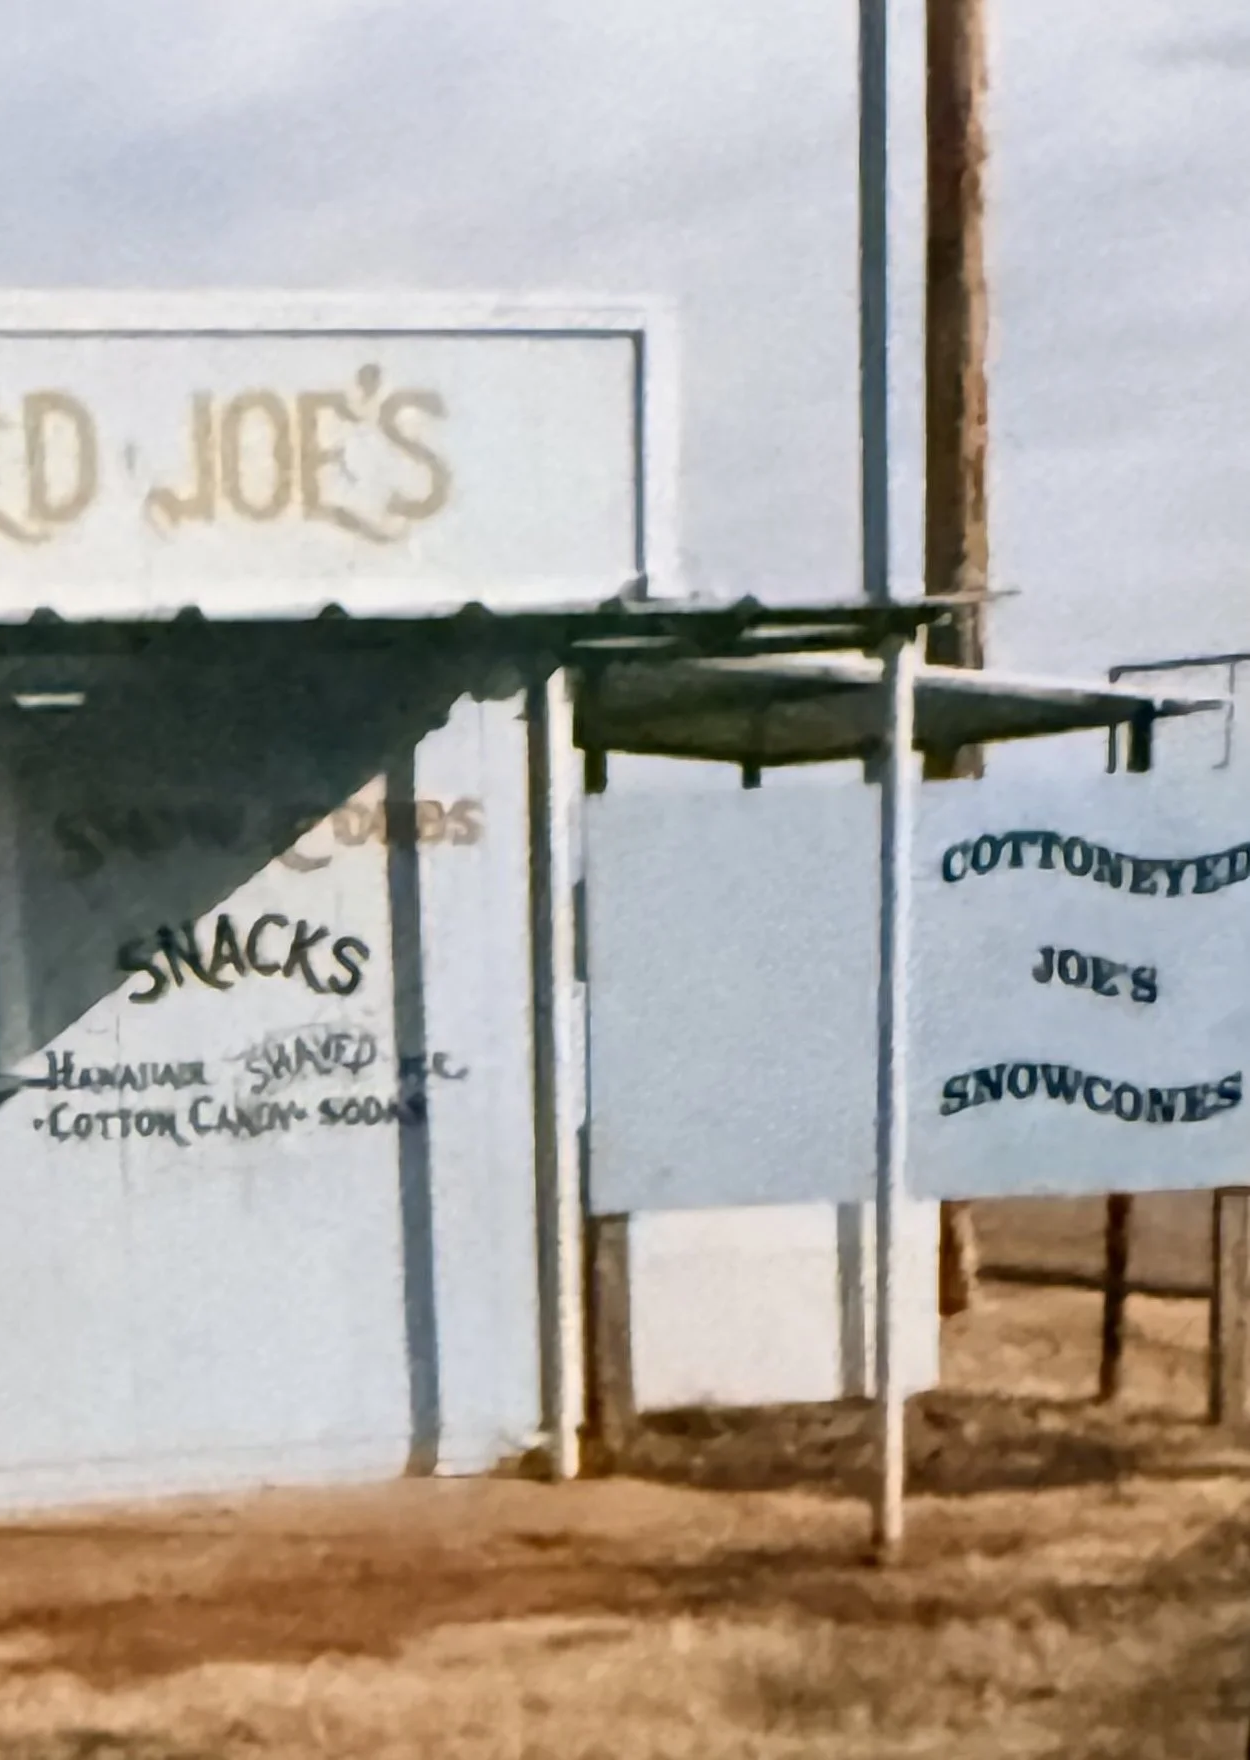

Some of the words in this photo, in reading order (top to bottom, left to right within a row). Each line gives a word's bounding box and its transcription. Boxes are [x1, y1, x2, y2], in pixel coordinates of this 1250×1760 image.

[146, 363, 449, 544] JOE'S
[941, 830, 1250, 897] COTTONEYED
[117, 912, 371, 1004] SNACKS
